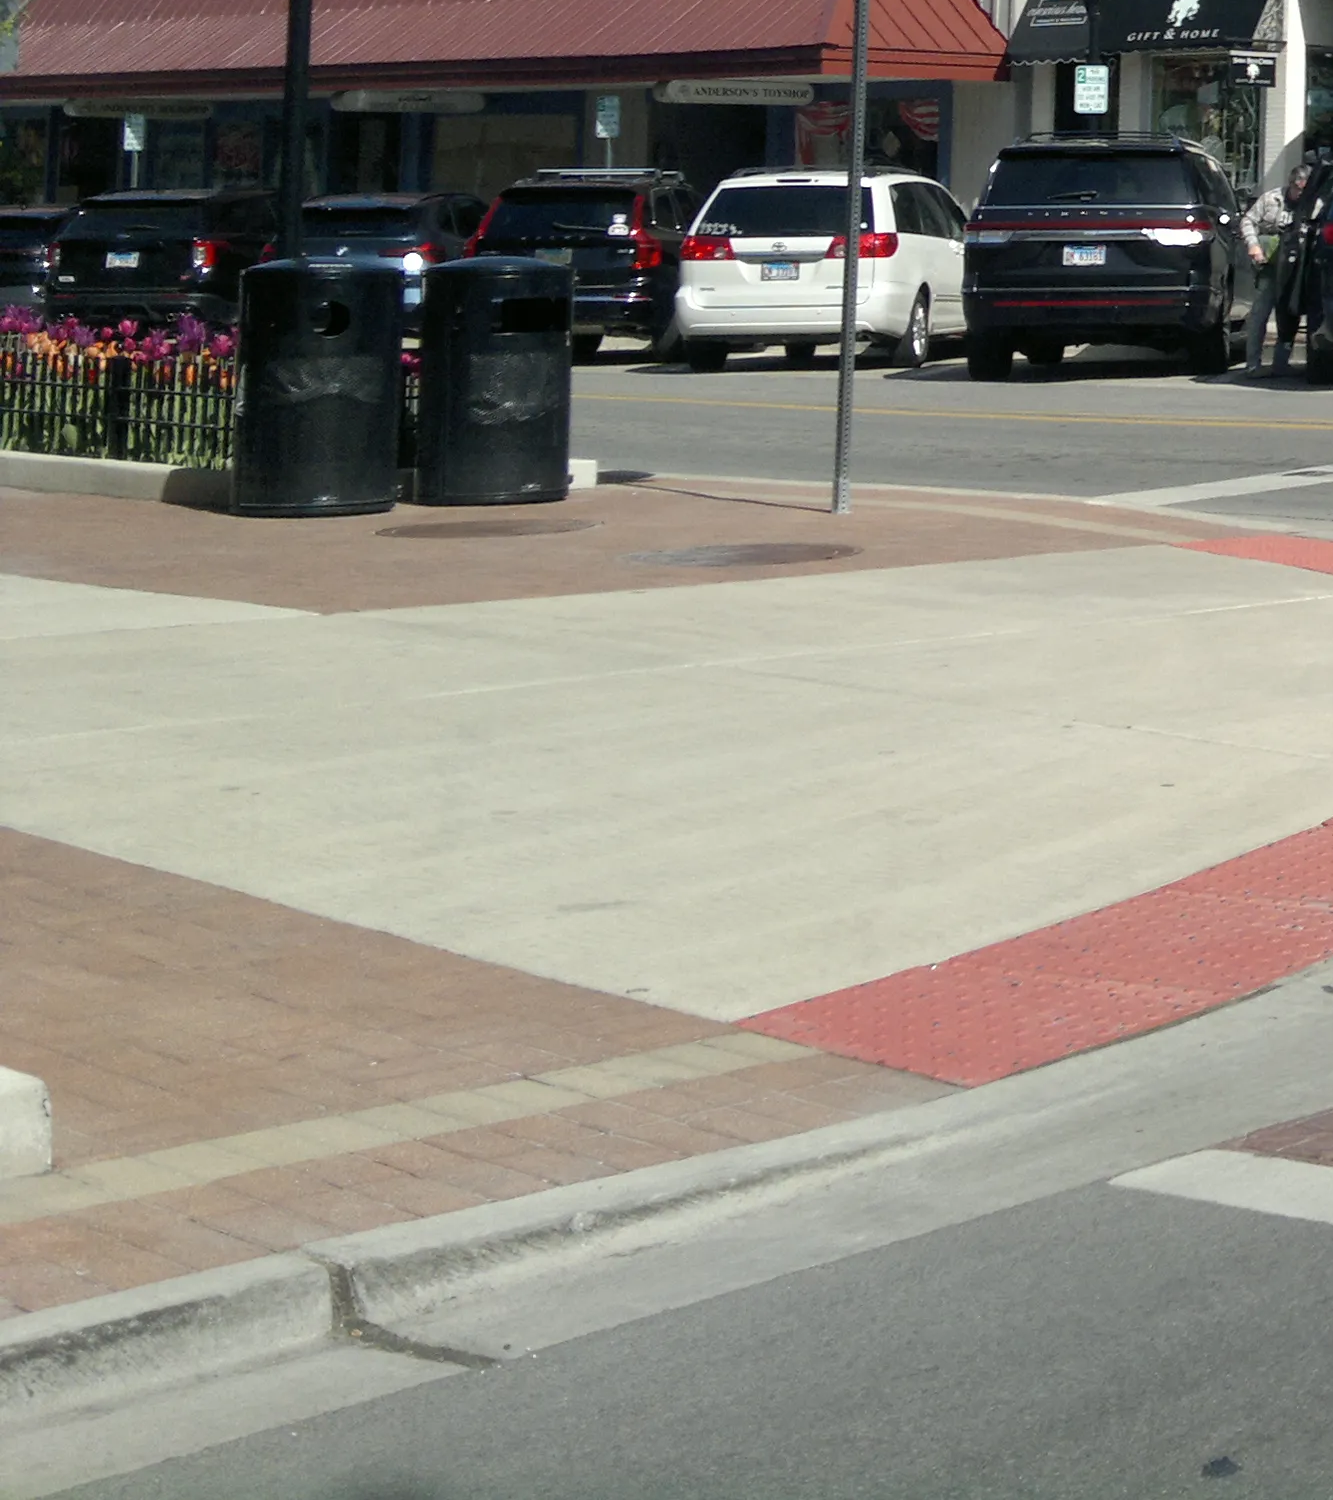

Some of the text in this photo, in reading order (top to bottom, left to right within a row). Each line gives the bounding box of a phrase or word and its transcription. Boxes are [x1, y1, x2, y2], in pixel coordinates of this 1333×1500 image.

[1126, 27, 1220, 42] GIFT & HOME
[1078, 69, 1085, 82] 2
[693, 86, 810, 99] ANDERSON'S TOYSHOP
